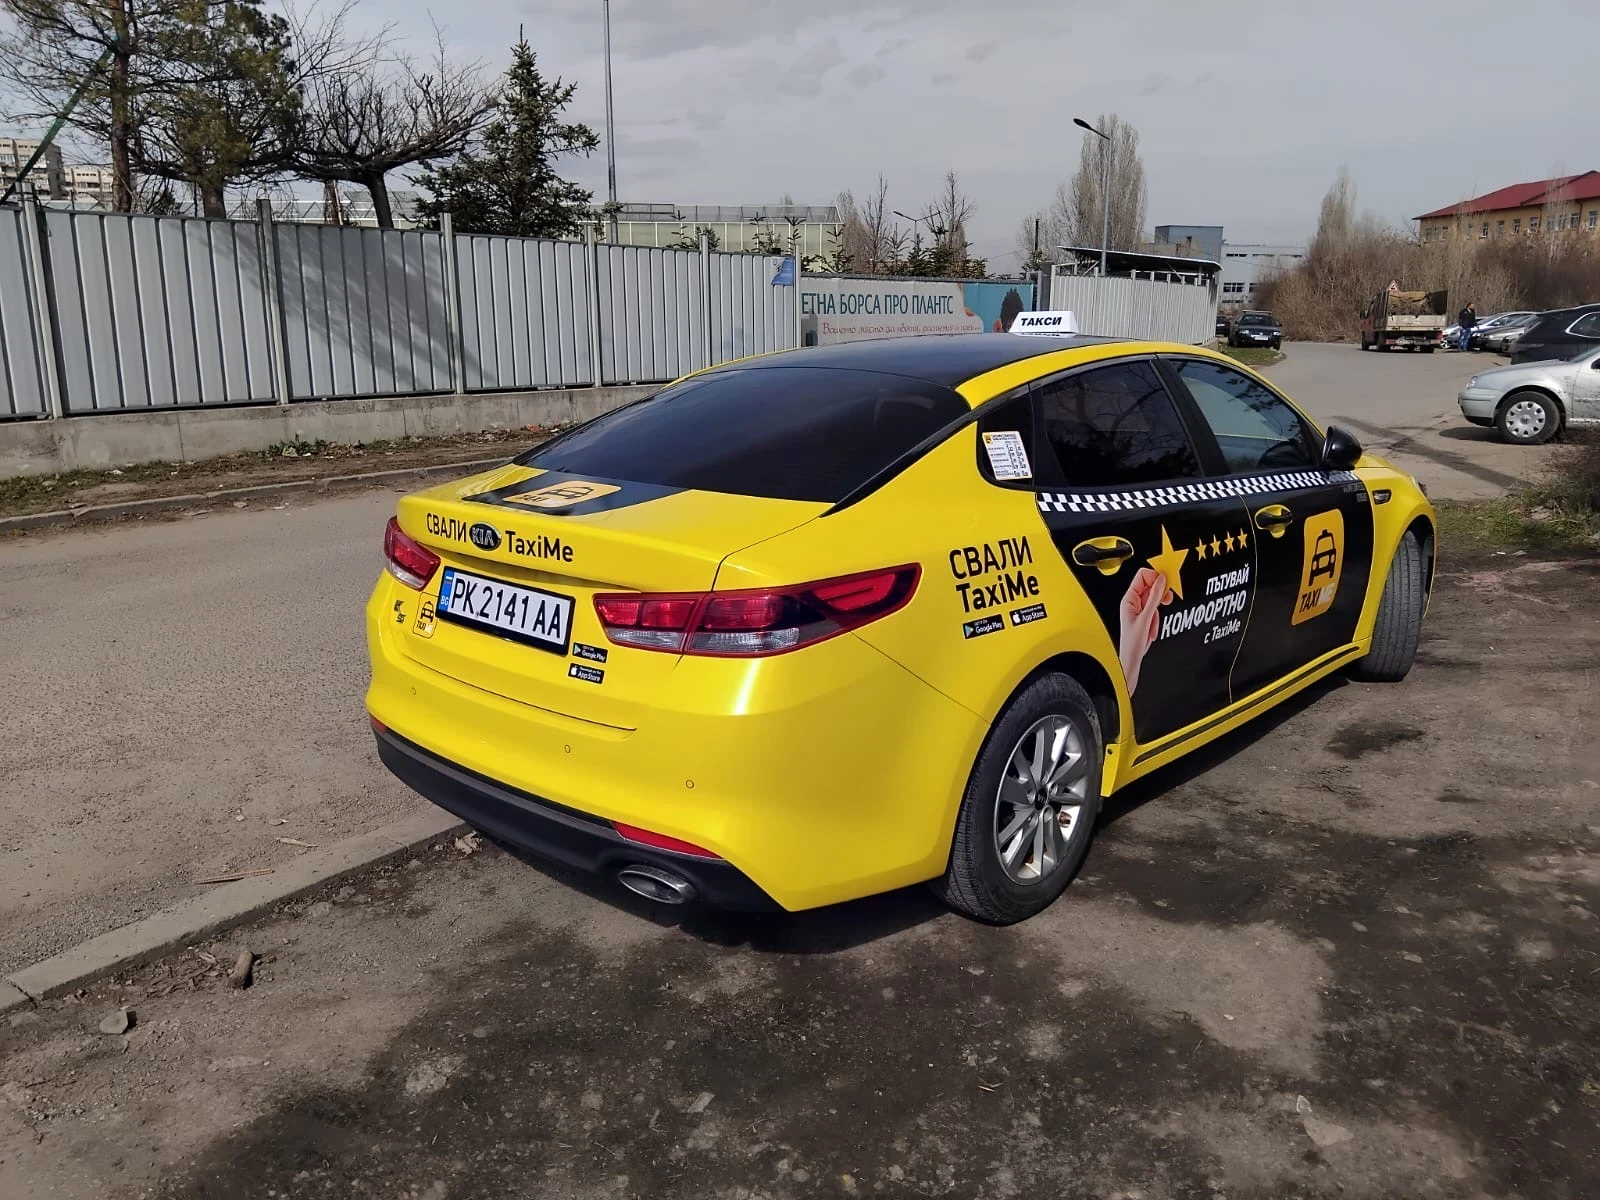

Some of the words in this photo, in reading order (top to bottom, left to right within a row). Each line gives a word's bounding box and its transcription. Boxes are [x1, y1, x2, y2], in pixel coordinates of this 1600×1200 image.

[801, 292, 836, 315] ЕТНА
[840, 293, 881, 315] БОРСА
[885, 294, 908, 315] ПРО
[912, 295, 954, 315] ПЛАНТС
[1021, 317, 1062, 326] ТАКСИ
[426, 512, 467, 543] СВАЛИ
[471, 526, 495, 547] KIA
[505, 530, 574, 562] TaxiMe
[949, 535, 1033, 580] СВАЛИ
[956, 571, 1041, 613] TaxiMe
[1206, 563, 1250, 596] ПЪТУВАЙ
[975, 624, 993, 634] Google
[1022, 614, 1033, 622] App
[1161, 590, 1247, 640] КОМФОРТНО
[1204, 632, 1211, 645] с
[1211, 618, 1241, 641] TaxiMe
